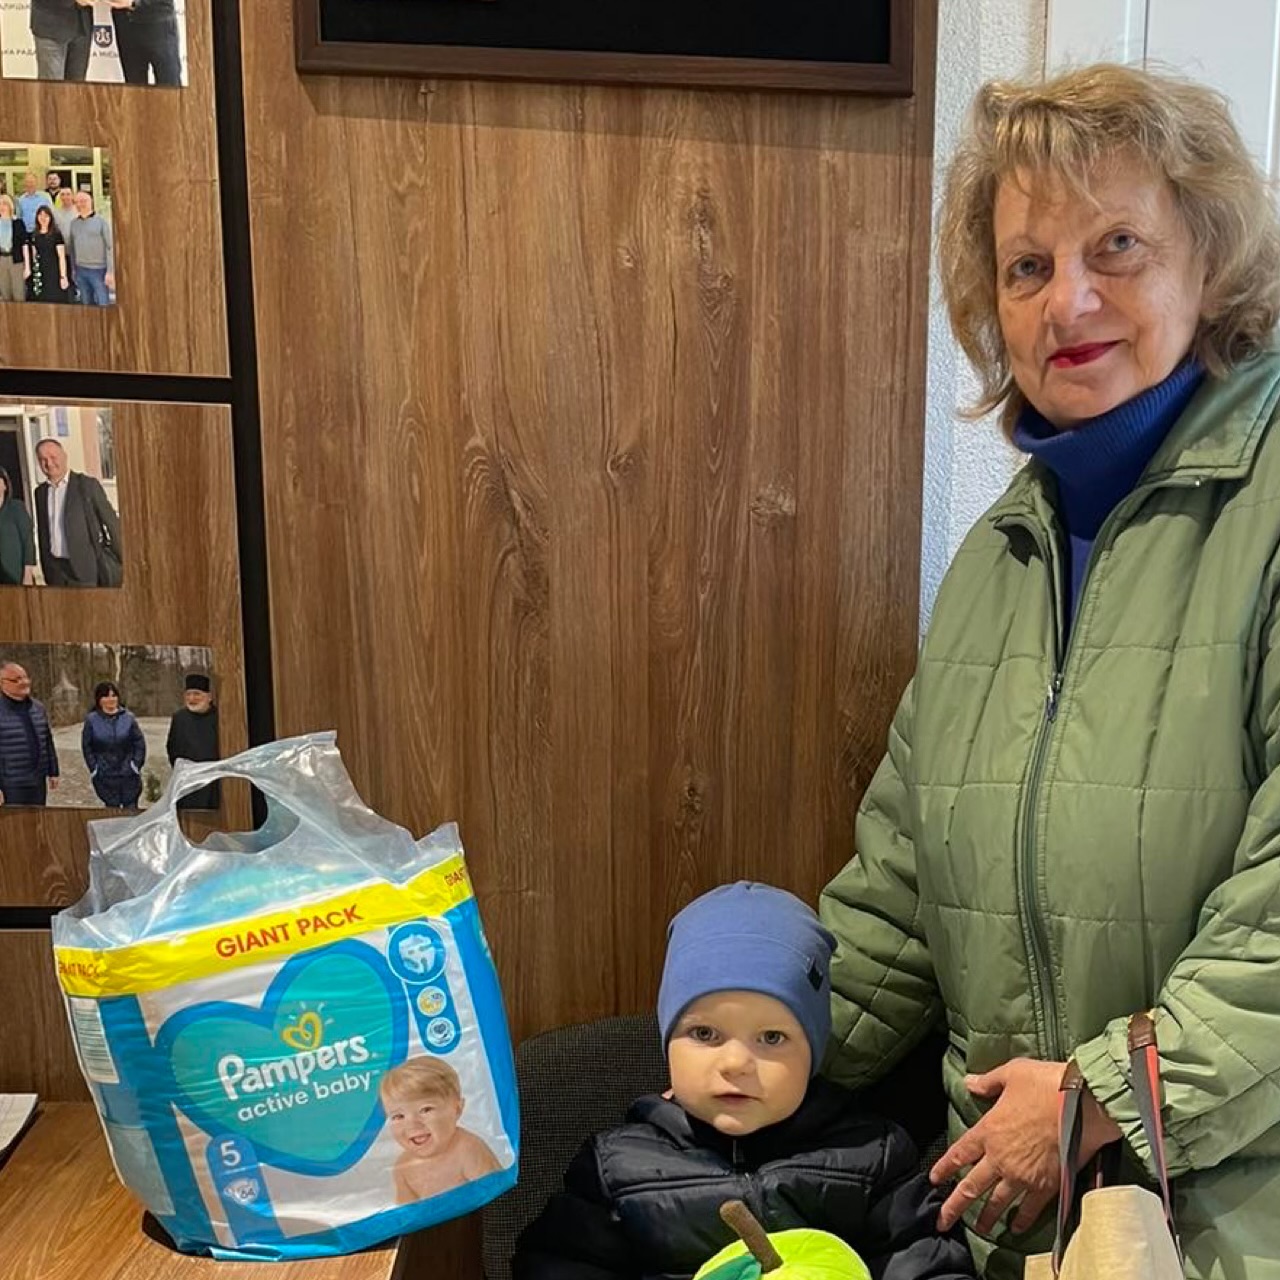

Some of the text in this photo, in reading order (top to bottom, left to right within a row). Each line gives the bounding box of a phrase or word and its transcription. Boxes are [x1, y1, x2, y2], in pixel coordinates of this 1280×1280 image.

[216, 905, 364, 958] GIANT PACK
[217, 1036, 371, 1100] Pampers
[238, 1071, 371, 1121] active baby
[220, 1140, 241, 1167] 5
